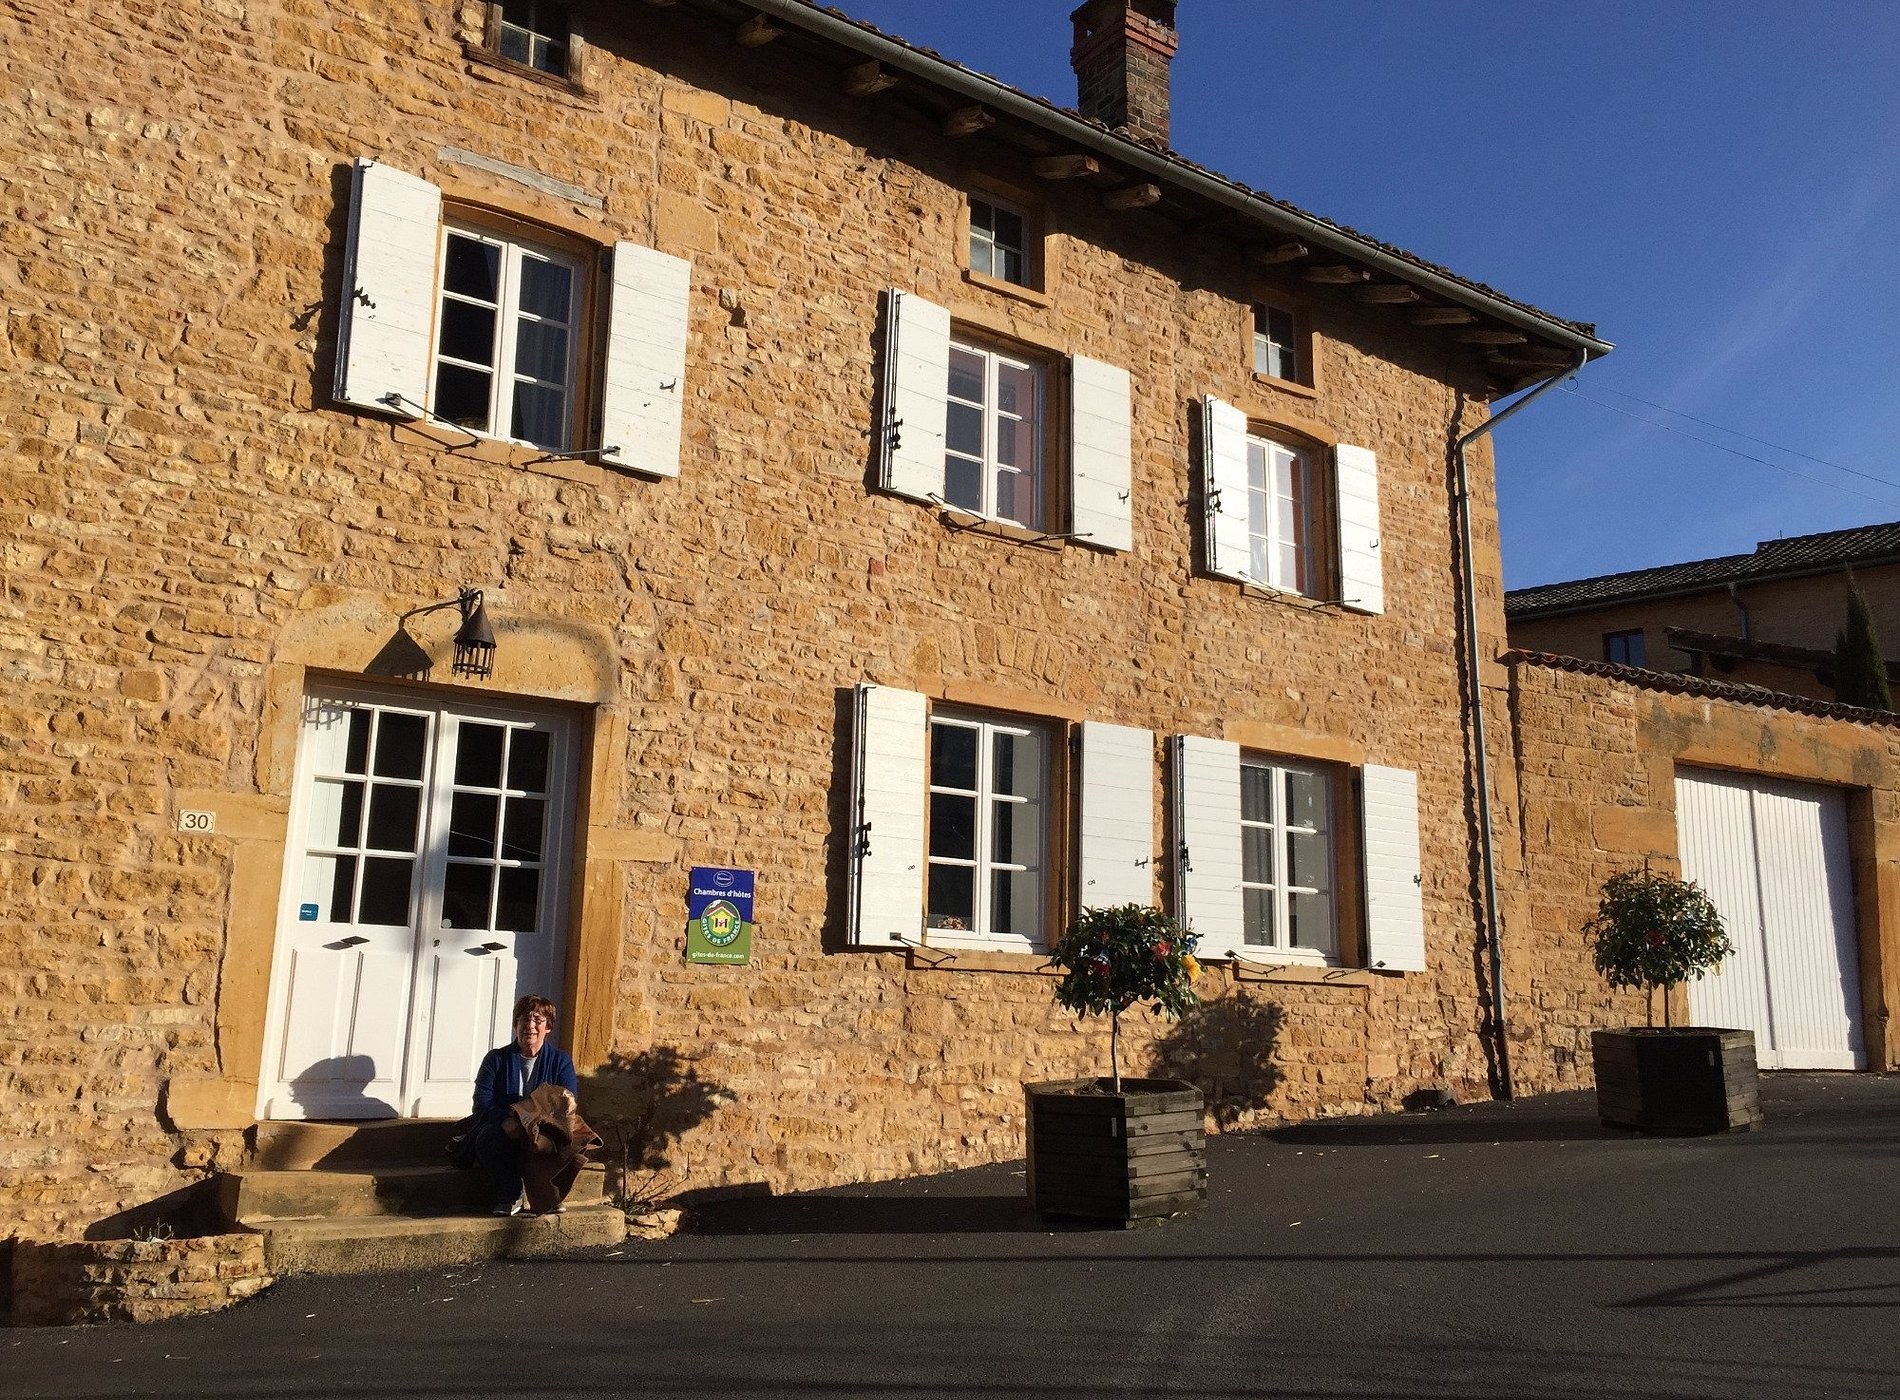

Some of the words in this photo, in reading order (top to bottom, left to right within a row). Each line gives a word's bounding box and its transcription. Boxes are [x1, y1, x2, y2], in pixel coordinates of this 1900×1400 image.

[185, 813, 208, 829] 30
[693, 888, 726, 897] Chambres
[727, 889, 751, 899] d'hôtes
[723, 920, 740, 944] FRANCE
